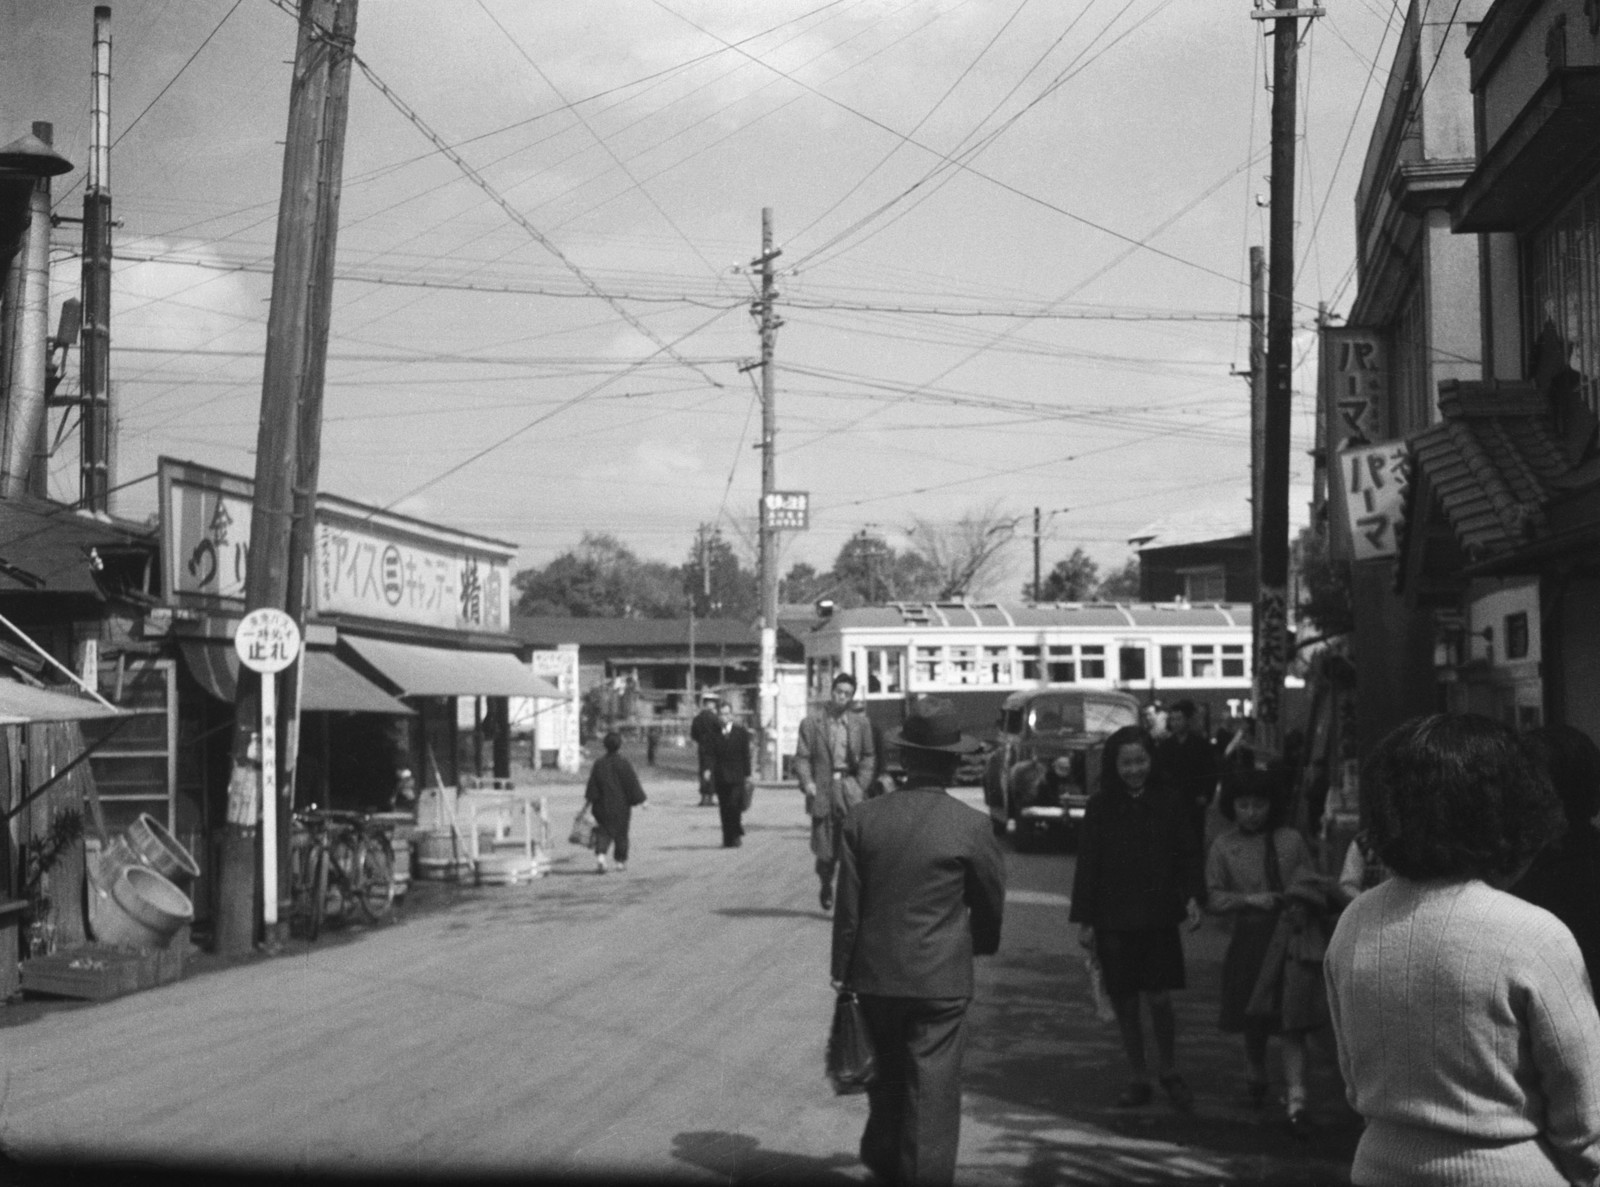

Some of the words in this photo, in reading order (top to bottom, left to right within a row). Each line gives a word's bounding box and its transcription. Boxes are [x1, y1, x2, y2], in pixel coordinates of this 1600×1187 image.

[1338, 342, 1373, 440] パーマ
[1351, 455, 1386, 549] パーマ
